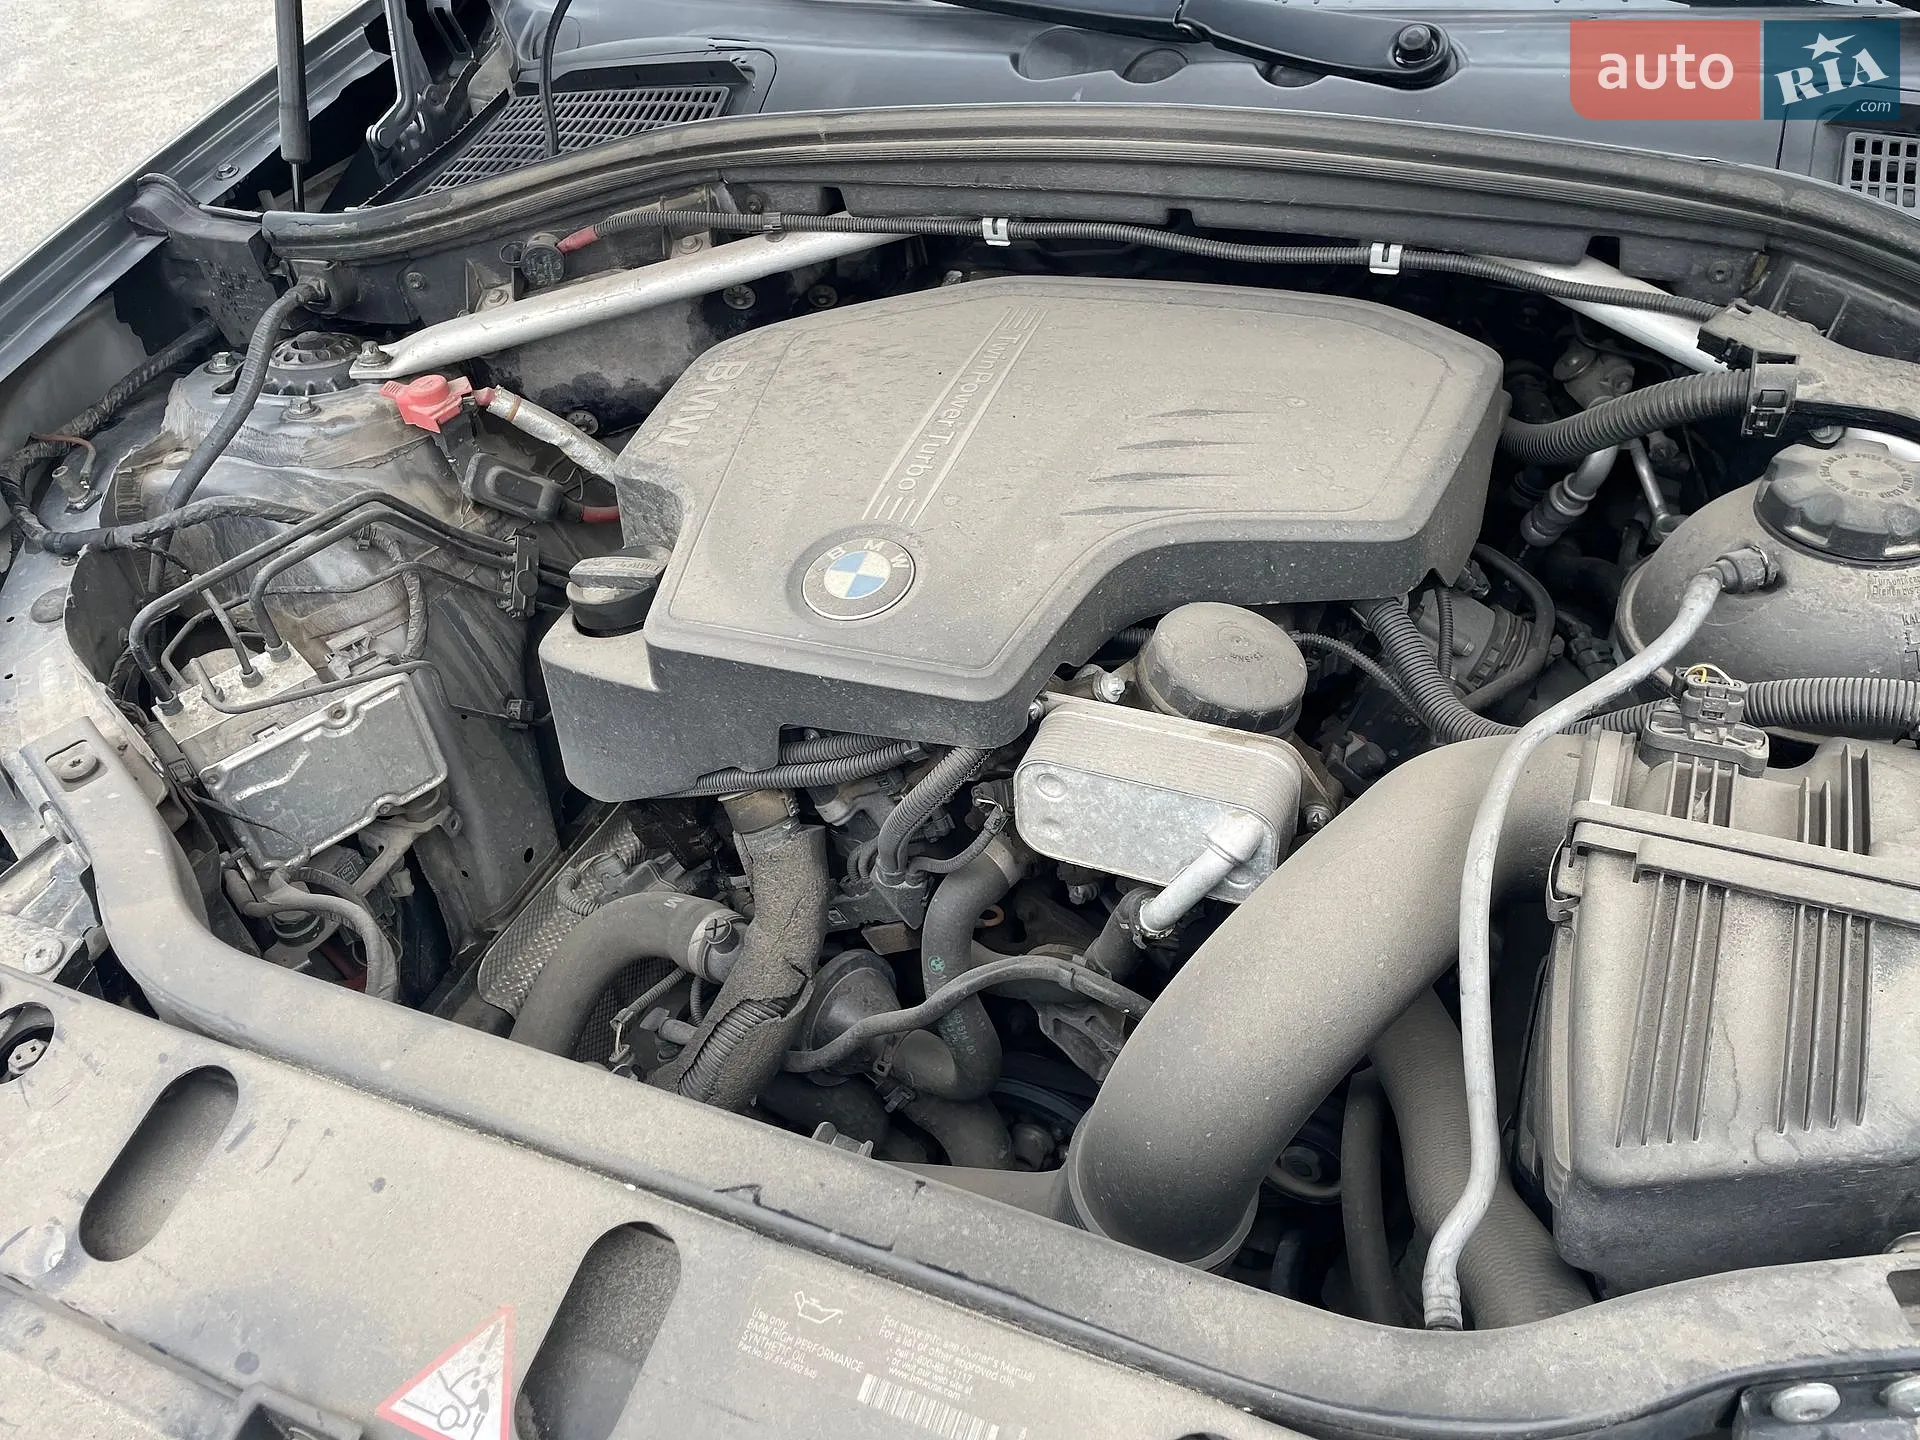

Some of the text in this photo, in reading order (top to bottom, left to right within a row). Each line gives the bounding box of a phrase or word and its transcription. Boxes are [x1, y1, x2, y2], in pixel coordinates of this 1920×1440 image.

[656, 361, 753, 447] BMW
[827, 540, 910, 568] BMW
[741, 1329, 791, 1356] SYNTHETIC
[746, 1318, 865, 1373] BMW HIGH PERFORMANCE
